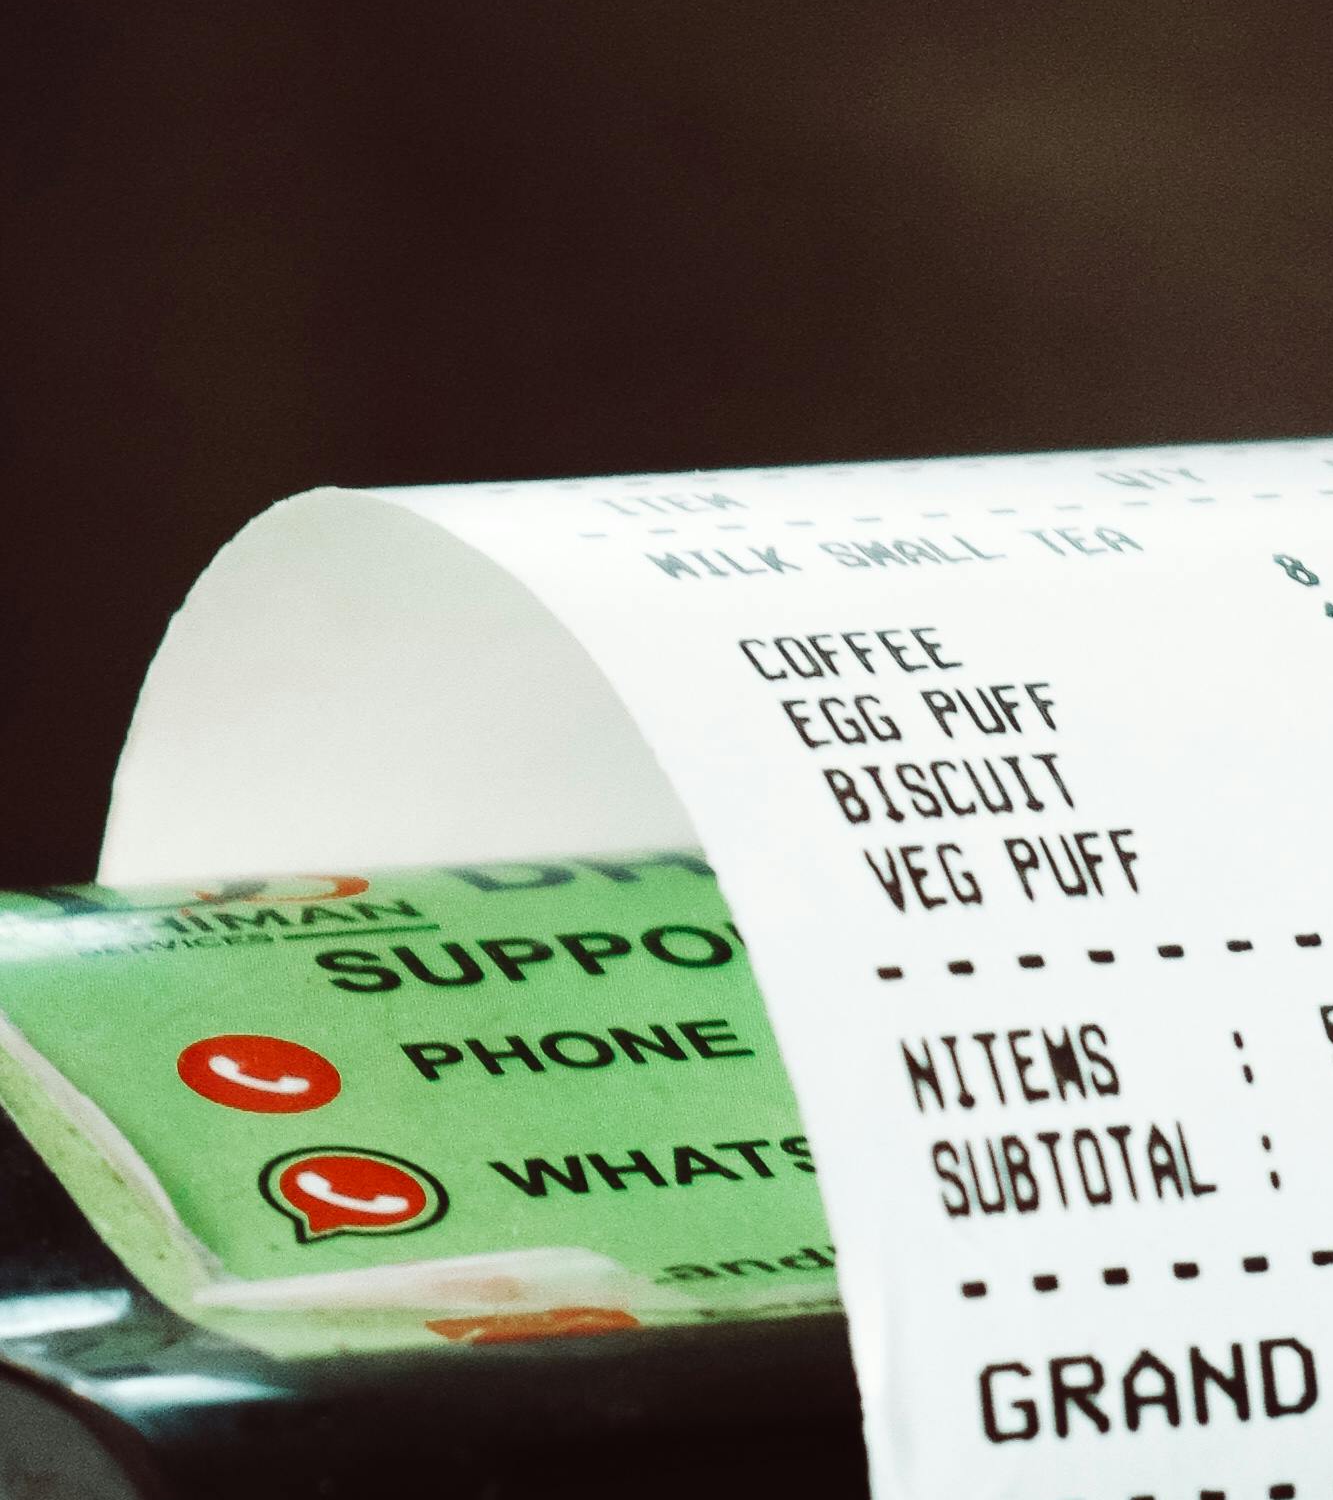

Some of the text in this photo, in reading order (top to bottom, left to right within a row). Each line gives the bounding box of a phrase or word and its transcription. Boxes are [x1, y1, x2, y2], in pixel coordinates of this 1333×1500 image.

[601, 492, 747, 516] ITEM
[1094, 465, 1207, 491] QTY
[645, 527, 1144, 580] MILK SMALL TEA
[1274, 555, 1320, 588] 8
[738, 627, 963, 682] COFFEE
[780, 694, 903, 750] EGG
[919, 682, 1057, 739] PUFF
[822, 752, 1075, 826] BISCUIT
[863, 842, 984, 914] VEG
[1003, 828, 1140, 903] PUFF
[312, 920, 747, 996] SUPPO
[399, 1019, 755, 1082] PHONE
[900, 1023, 1121, 1113] NITEMS
[488, 1136, 816, 1198] WHATS
[931, 1122, 1218, 1219] SUBTOTAL
[978, 1336, 1320, 1445] GRAND
